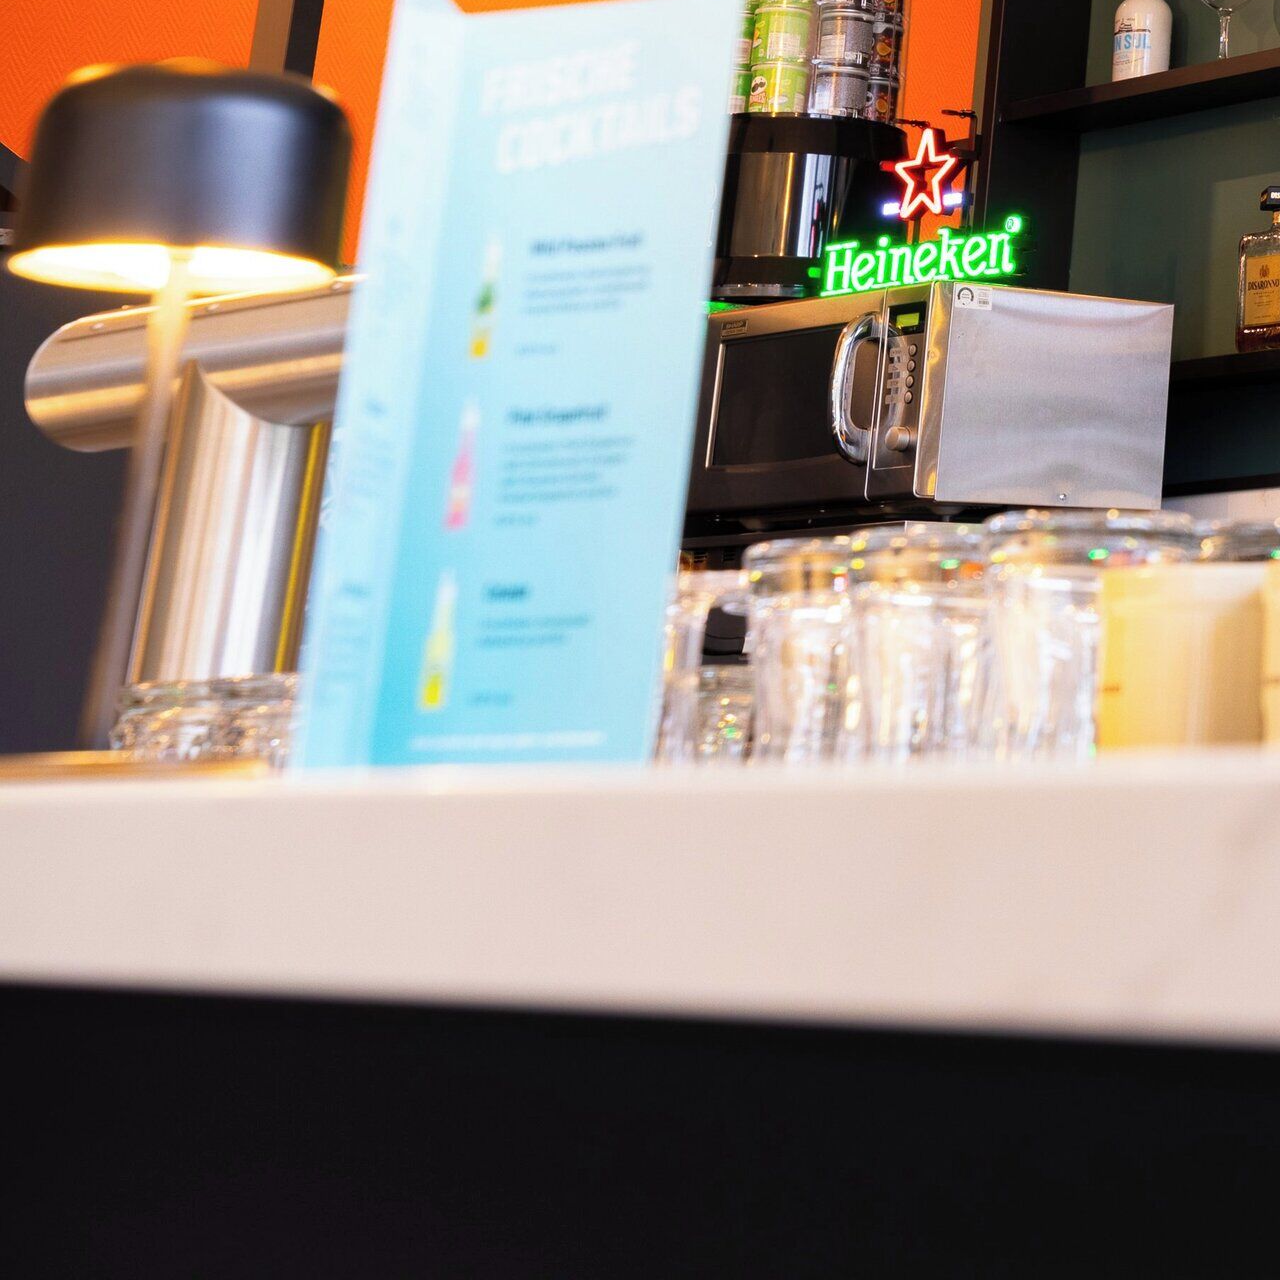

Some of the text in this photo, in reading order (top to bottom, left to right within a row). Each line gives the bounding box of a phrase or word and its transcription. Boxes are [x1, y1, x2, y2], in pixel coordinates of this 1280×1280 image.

[1124, 31, 1151, 50] SUL
[820, 226, 1016, 297] Heineken
[1248, 278, 1280, 292] DISARONNO
